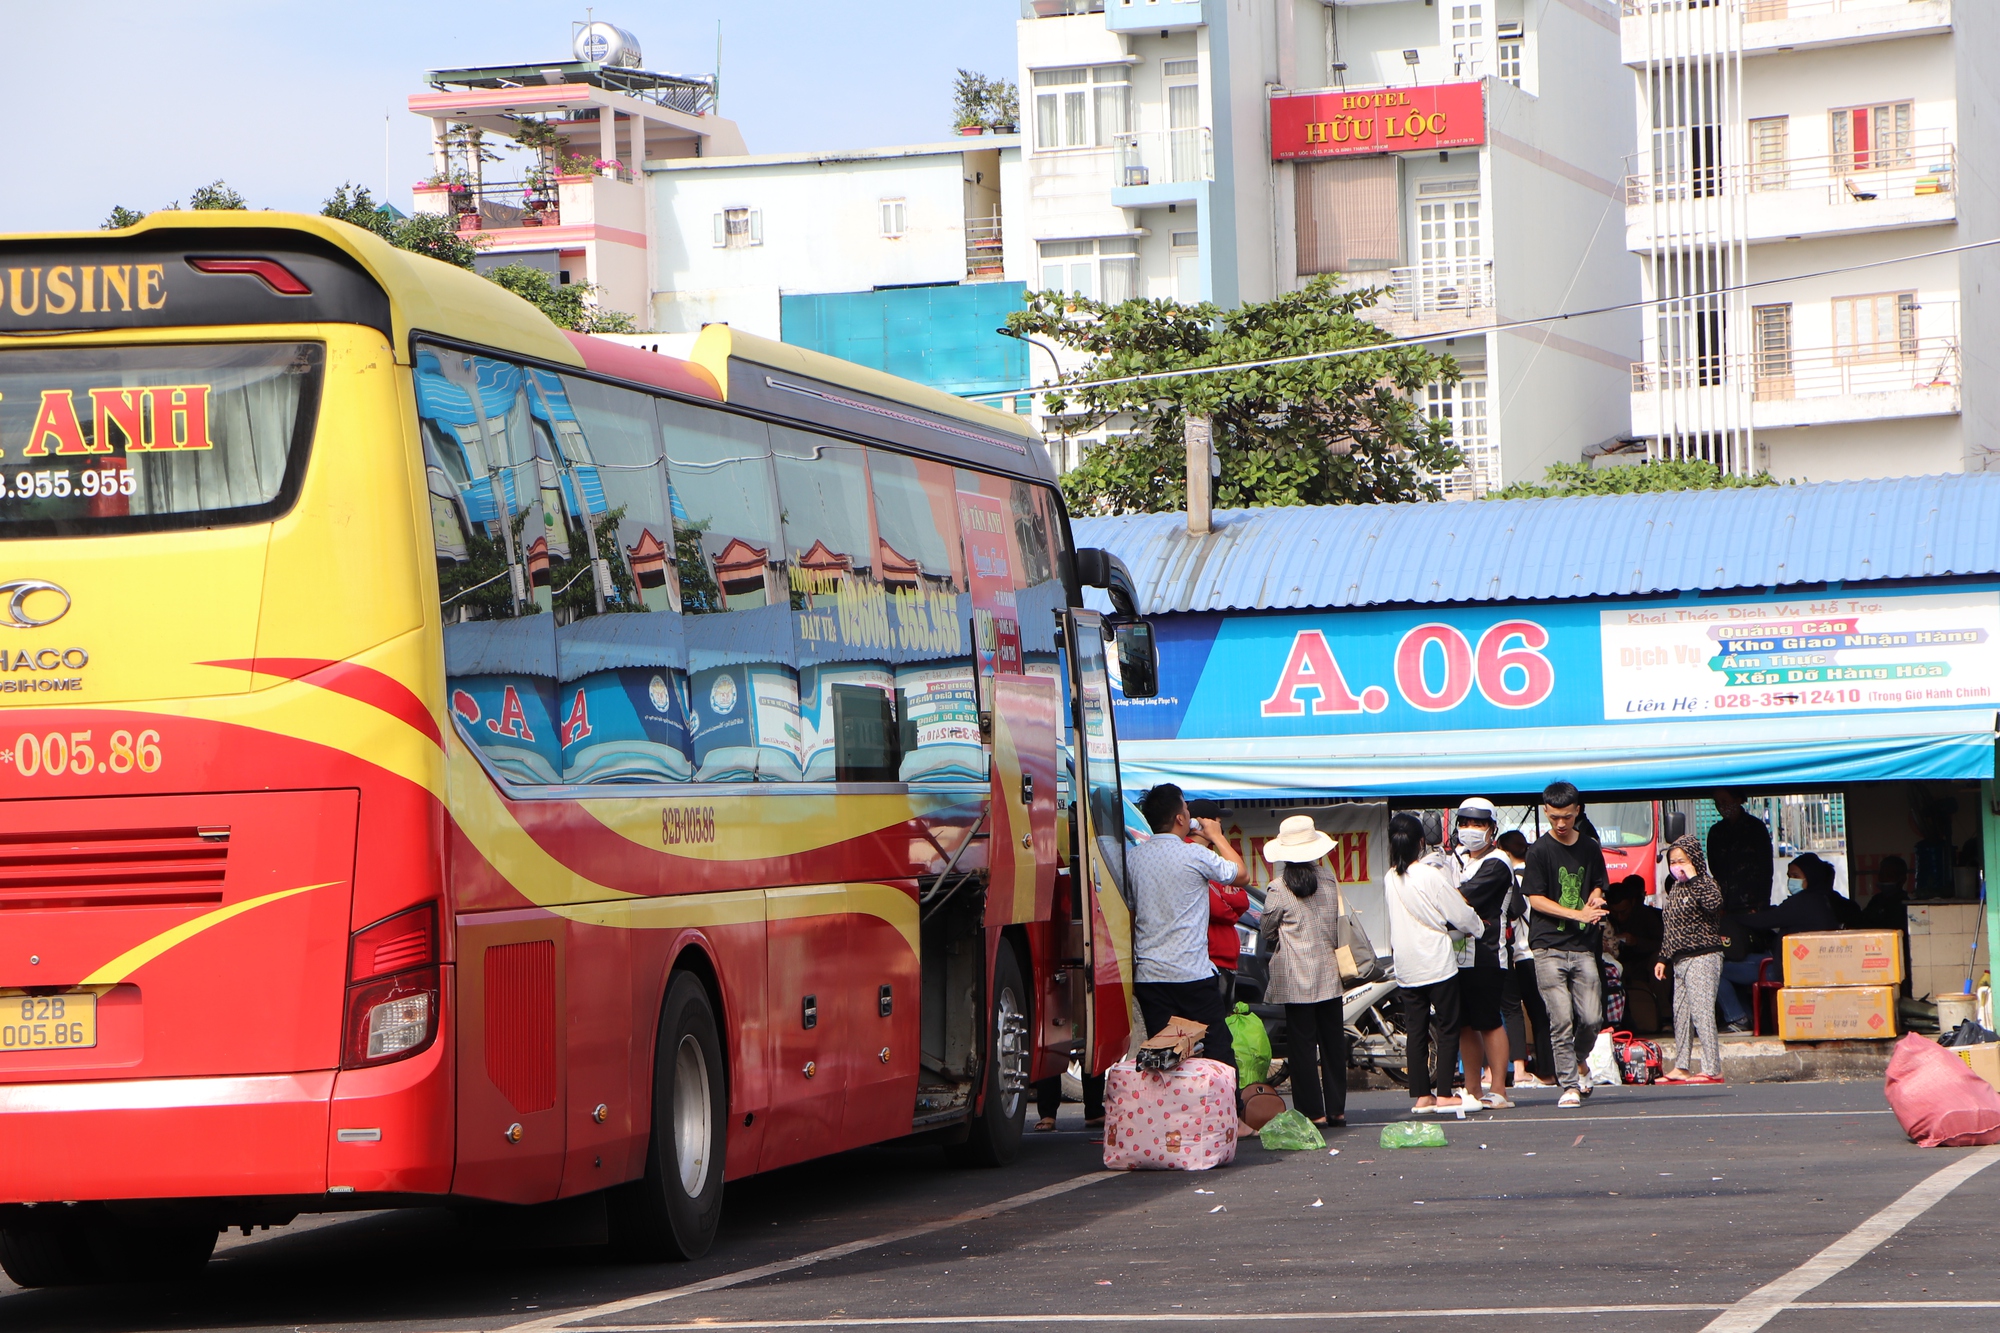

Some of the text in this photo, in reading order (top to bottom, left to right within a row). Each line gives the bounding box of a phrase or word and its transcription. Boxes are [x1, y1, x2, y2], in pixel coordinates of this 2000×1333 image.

[1342, 92, 1410, 110] HOTEL
[1305, 107, 1447, 144] HỮU LỘC
[0, 263, 167, 316] USINE
[23, 384, 213, 457] ANH
[969, 504, 1003, 534] TÂN ANH
[1627, 600, 1883, 625] Khai Thác Dịch Vụ Hỗ Trợ:
[1801, 621, 1848, 634] Cáo
[1729, 630, 1979, 653] Kho Giao Nhận Hàng
[1260, 618, 1555, 717] A.06
[1620, 644, 1701, 671] Dịch Vụ
[1768, 653, 1826, 668] Thực
[0, 678, 83, 693] BIHOME
[1734, 670, 1780, 686] Xếp
[1826, 667, 1888, 680] Hàng
[1895, 664, 1943, 678] Hóa
[1625, 698, 1666, 713] Liên
[1868, 691, 1902, 703] (Trong
[1905, 689, 1923, 701] Giờ
[1926, 687, 1953, 699] Hành
[21, 998, 65, 1021] 82B
[3, 1022, 83, 1047] 005.86
